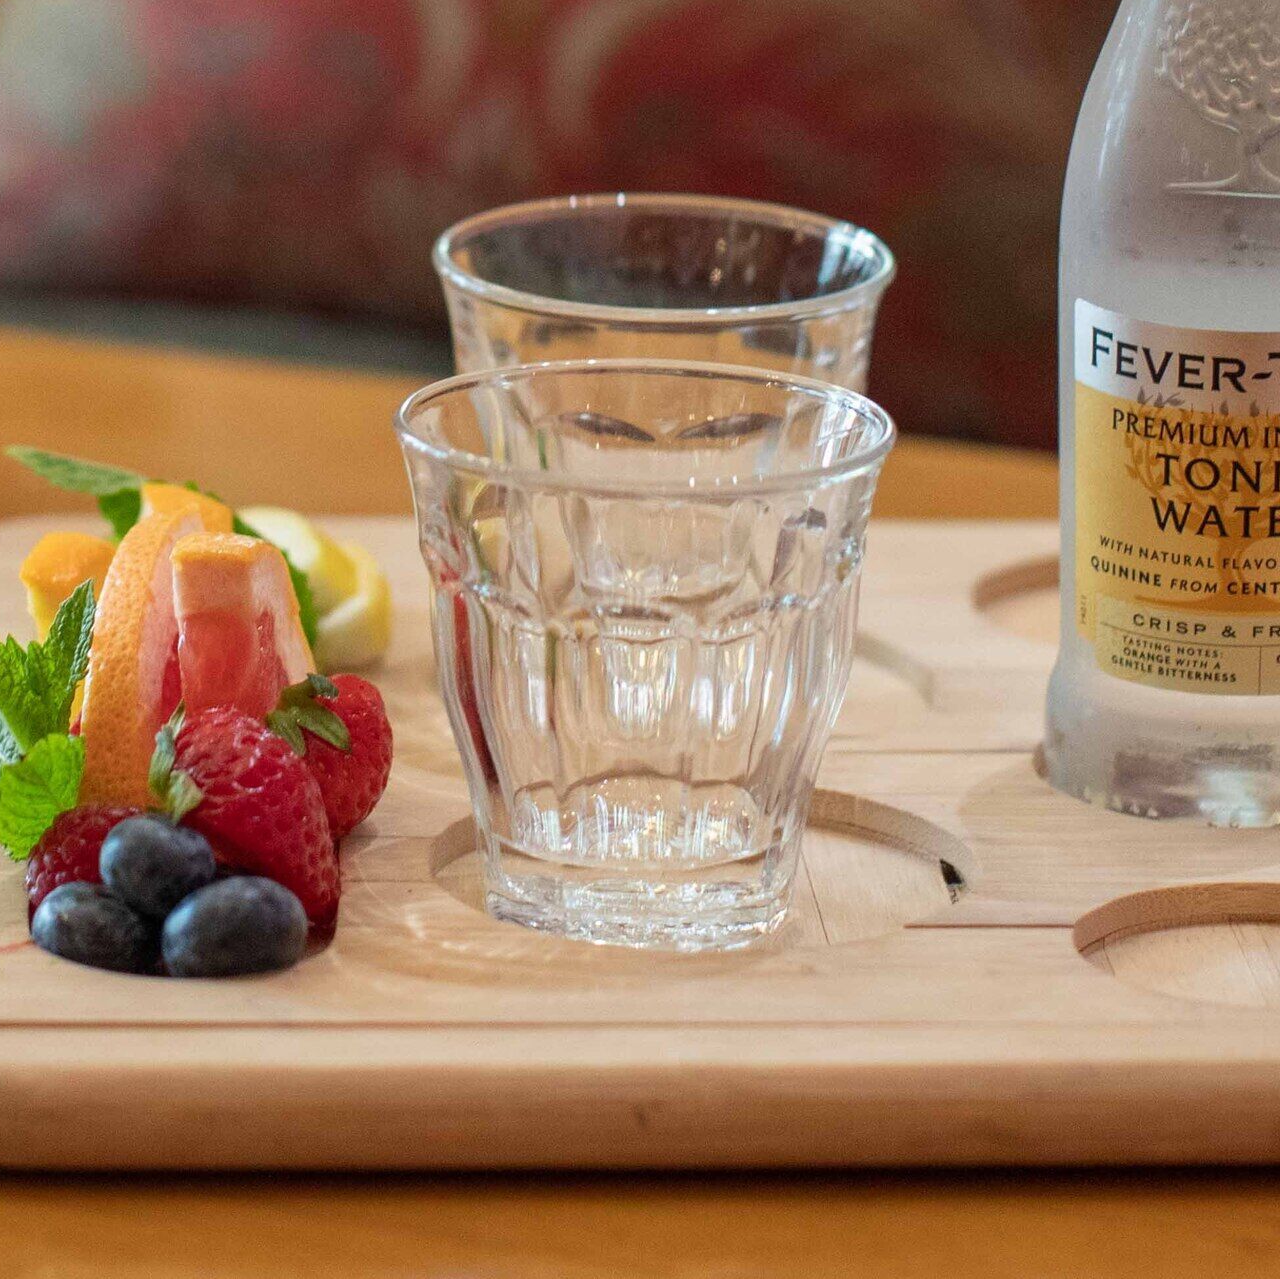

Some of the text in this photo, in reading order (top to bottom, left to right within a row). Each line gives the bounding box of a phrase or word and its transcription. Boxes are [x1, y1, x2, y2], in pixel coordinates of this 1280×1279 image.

[1112, 408, 1249, 448] PREMIUM
[1099, 535, 1133, 556] WITH
[1139, 548, 1214, 569] NATURAL
[1090, 556, 1162, 587] QUININE
[1170, 579, 1217, 593] FROM
[1133, 613, 1207, 635] CRISP
[1221, 625, 1236, 638] &
[1122, 636, 1172, 653] TASTING
[1123, 647, 1221, 669] ORANGE WITH A
[1112, 655, 1236, 682] GENTLE BITTERNESS
